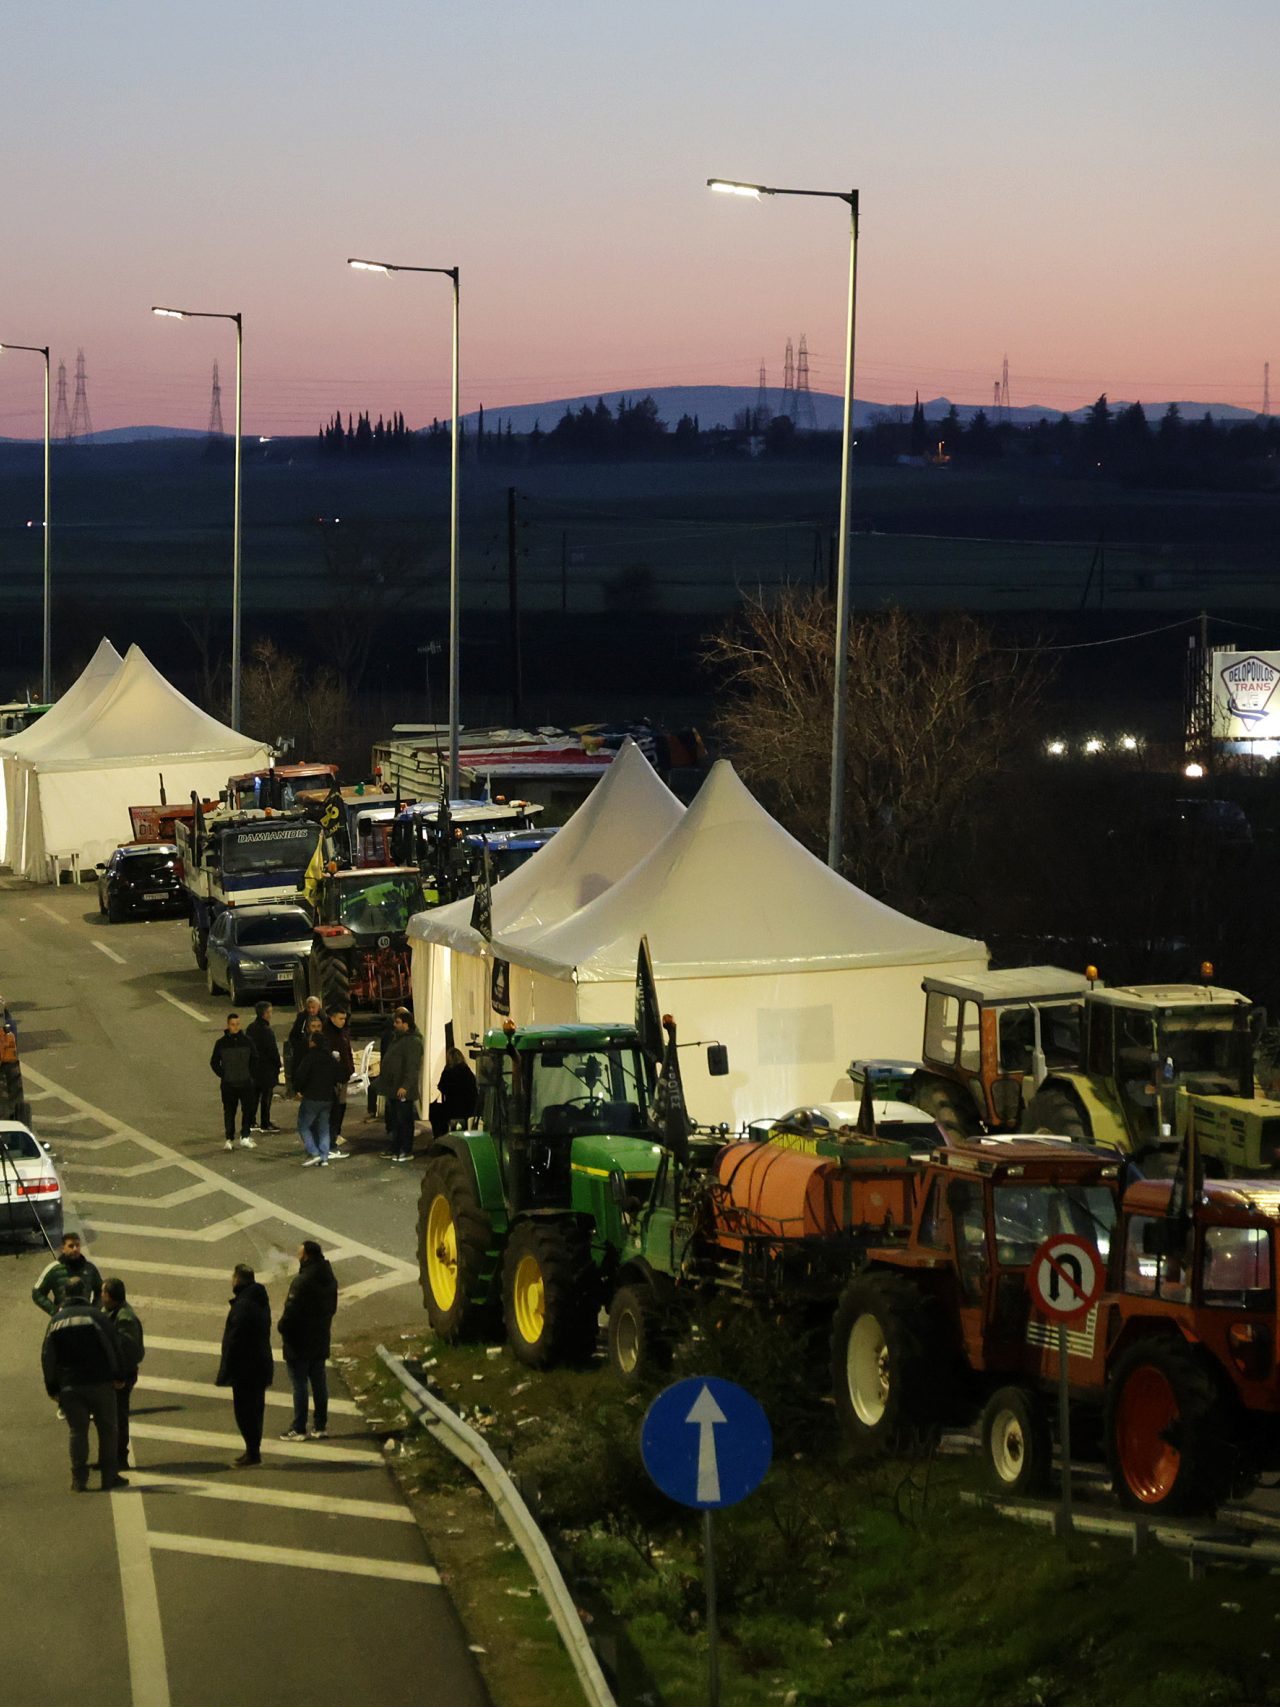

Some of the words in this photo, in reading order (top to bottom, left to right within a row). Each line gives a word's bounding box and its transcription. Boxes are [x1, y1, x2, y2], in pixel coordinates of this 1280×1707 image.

[1228, 661, 1274, 683] DELOPOULOS
[1234, 682, 1272, 692] TRANS
[237, 829, 308, 843] DAMIANIDIS
